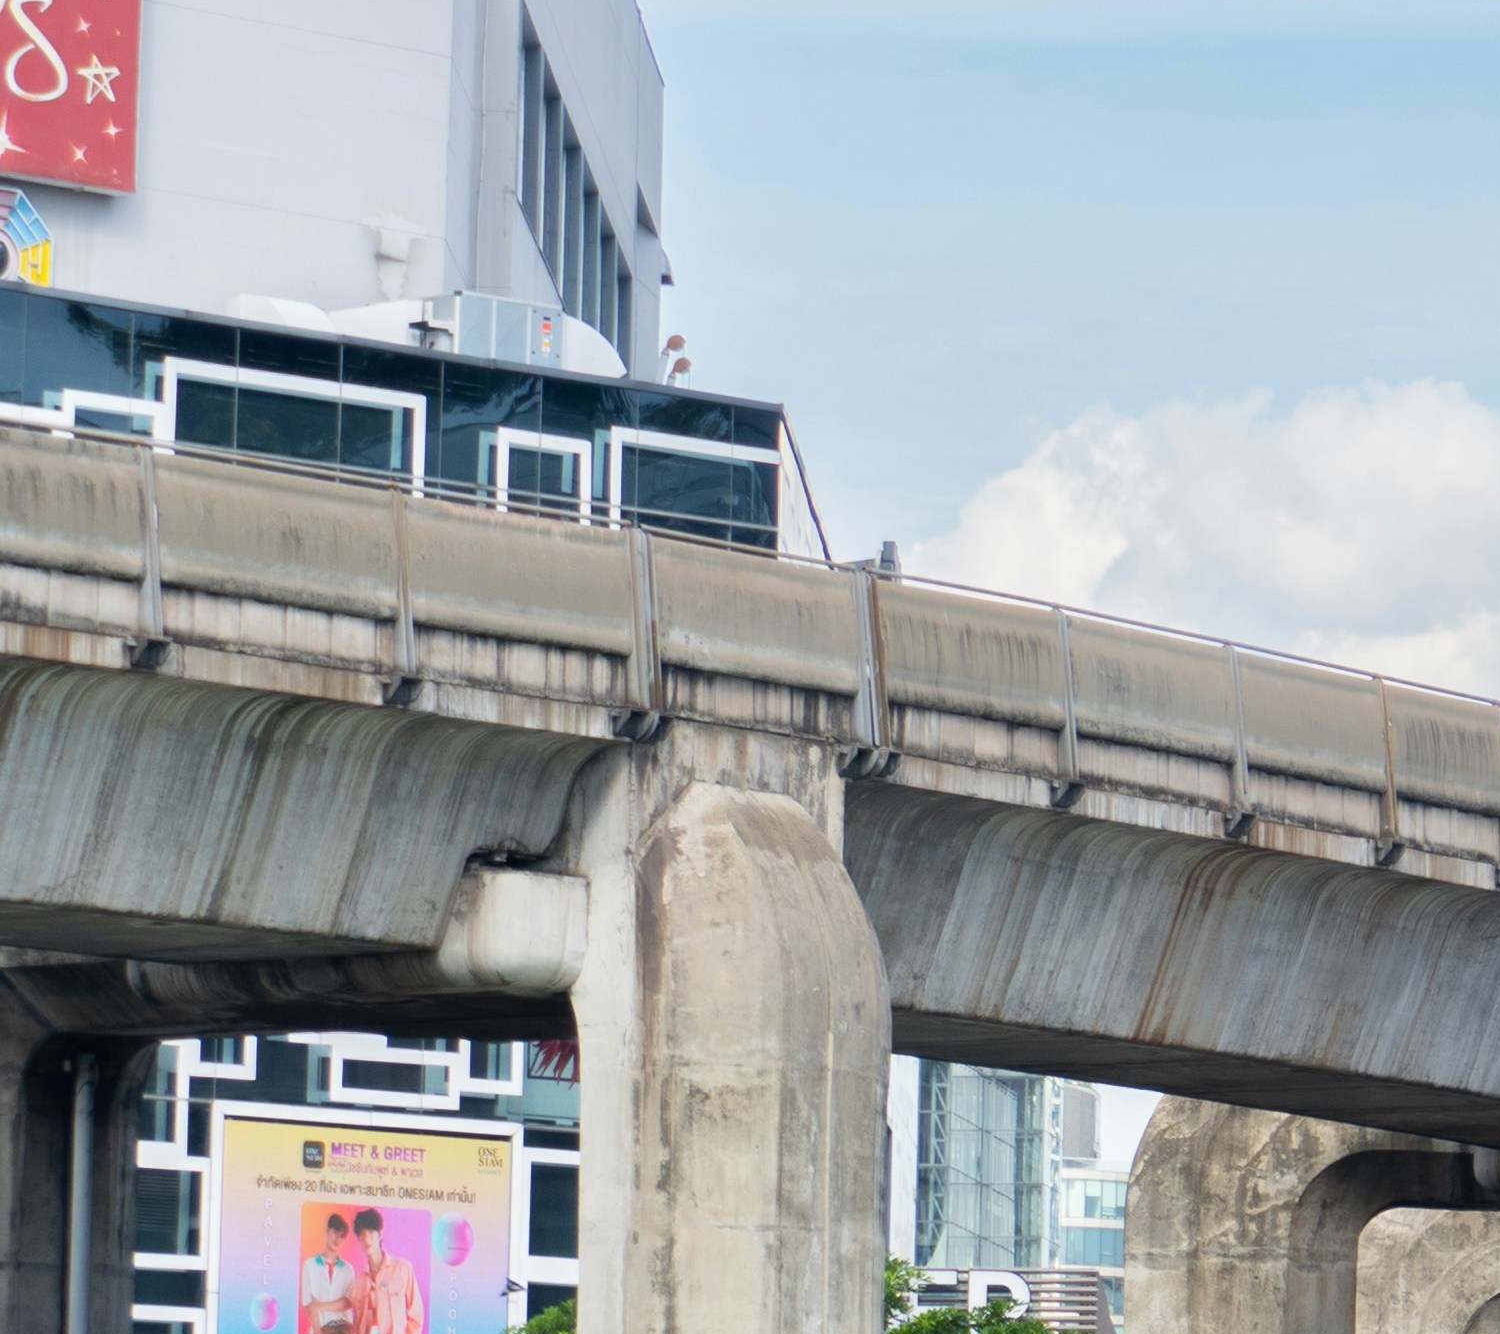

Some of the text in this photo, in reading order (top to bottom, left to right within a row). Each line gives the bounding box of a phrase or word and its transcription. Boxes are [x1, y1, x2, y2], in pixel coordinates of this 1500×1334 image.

[331, 1142, 426, 1163] MEET & GREET
[478, 1147, 499, 1158] ONE
[478, 1158, 504, 1168] SIAM
[305, 1180, 317, 1192] 20
[399, 1187, 444, 1201] ONESIAM
[263, 1197, 273, 1287] PAVEL
